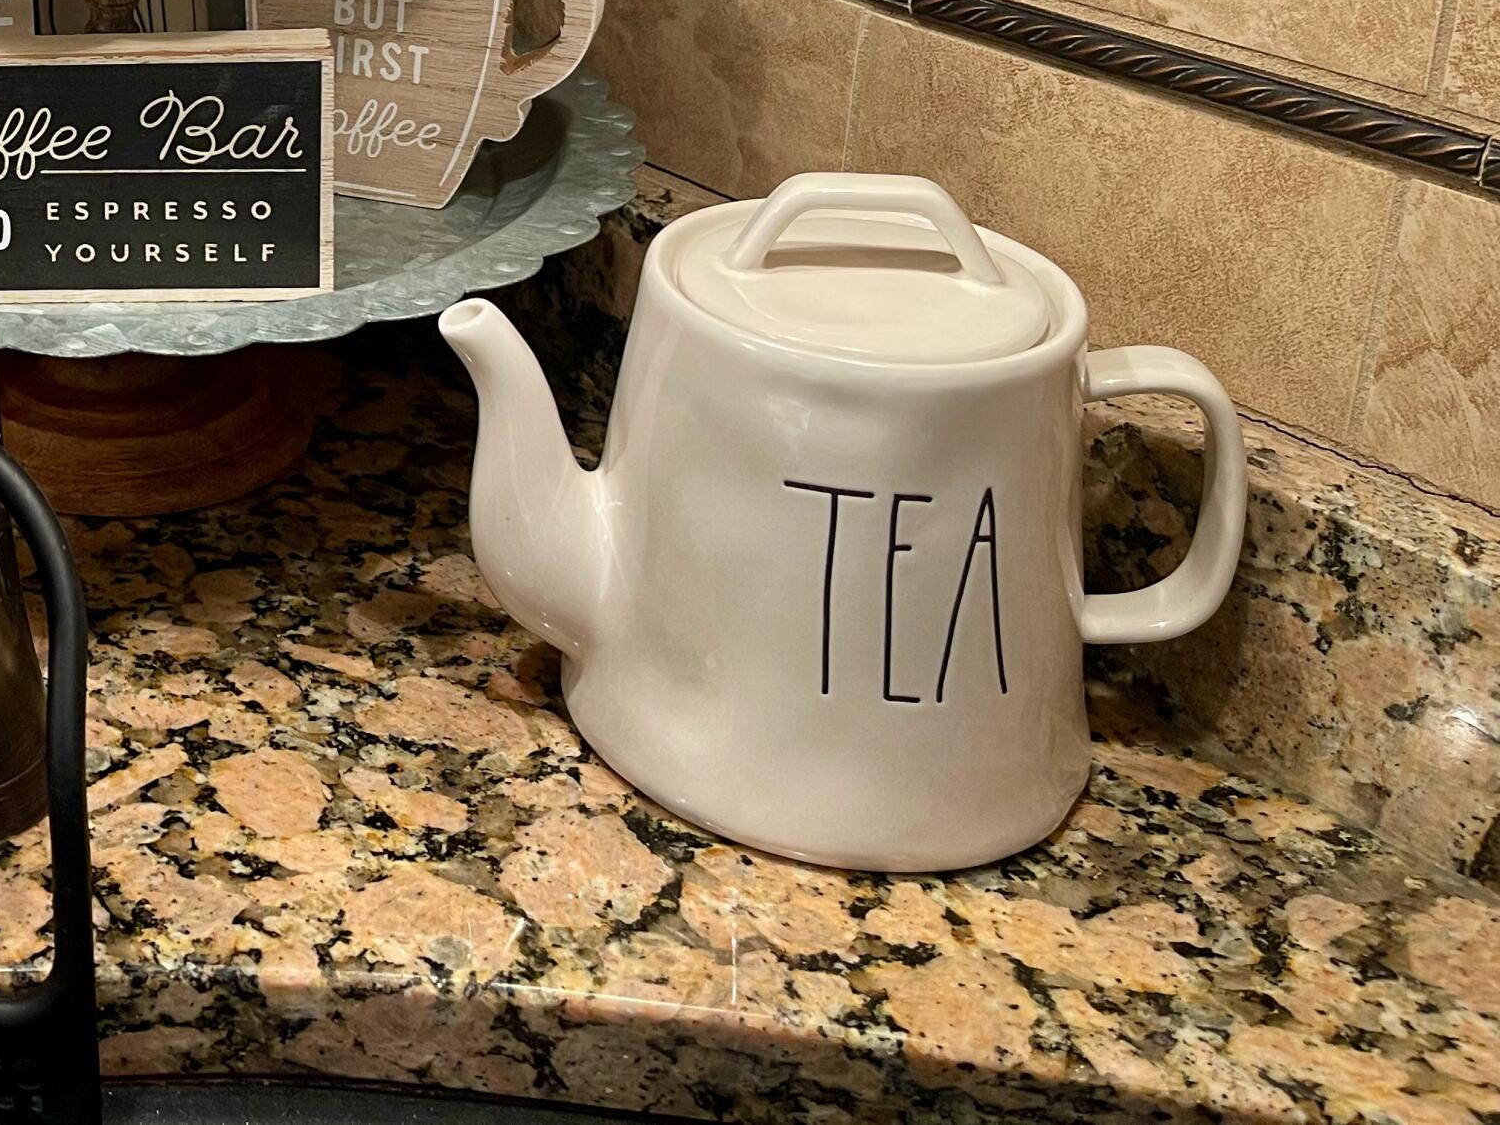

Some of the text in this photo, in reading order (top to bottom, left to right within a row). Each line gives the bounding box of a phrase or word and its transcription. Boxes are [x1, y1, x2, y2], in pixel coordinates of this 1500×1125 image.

[334, 35, 430, 85] IRST
[139, 89, 304, 165] Bar
[333, 99, 442, 159] offee
[46, 200, 272, 222] ESPRESSO
[44, 243, 277, 264] YOURSELF
[783, 479, 1009, 703] TEA
